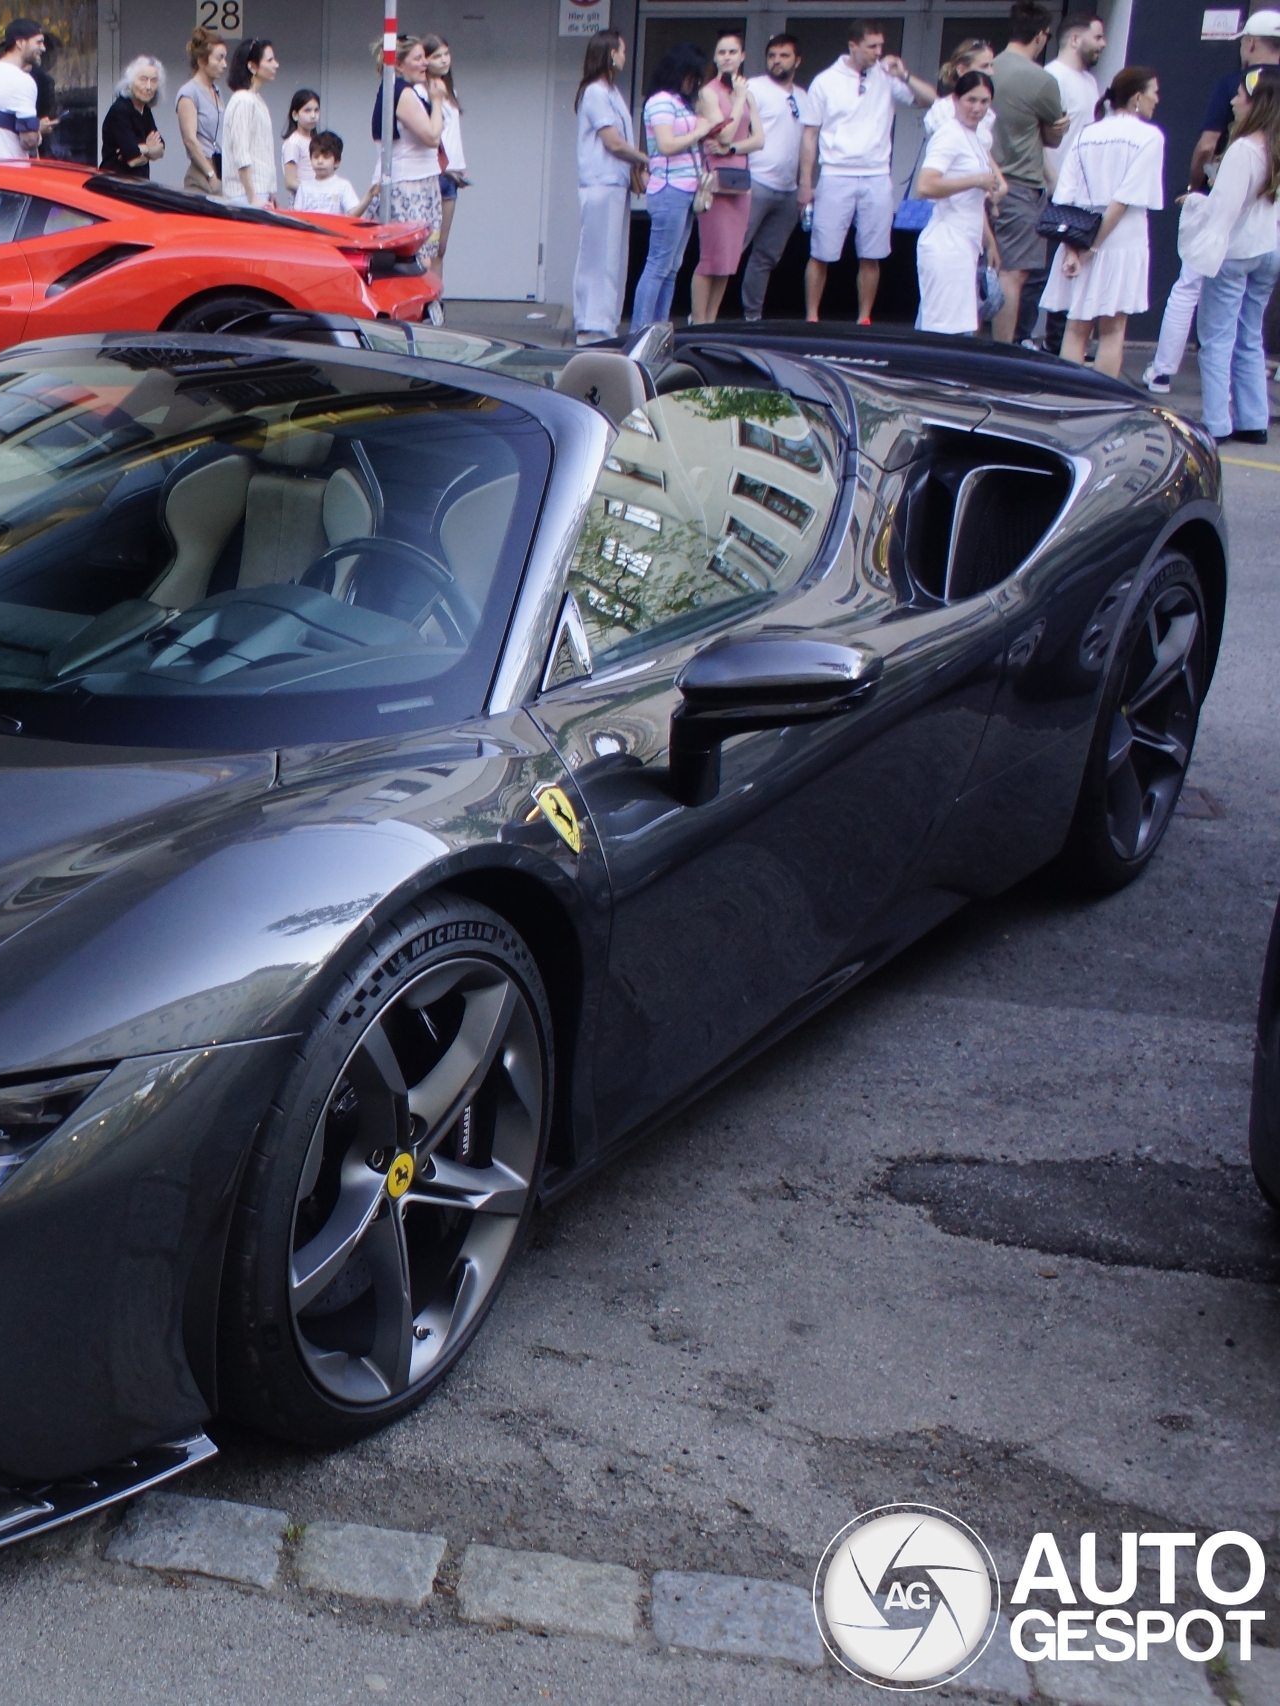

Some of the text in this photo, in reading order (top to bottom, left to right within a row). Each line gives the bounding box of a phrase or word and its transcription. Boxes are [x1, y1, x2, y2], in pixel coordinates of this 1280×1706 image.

[200, 1, 240, 30] 28
[568, 12, 600, 22] Hier gilt
[568, 23, 579, 32] die
[412, 923, 495, 959] MICHELIN
